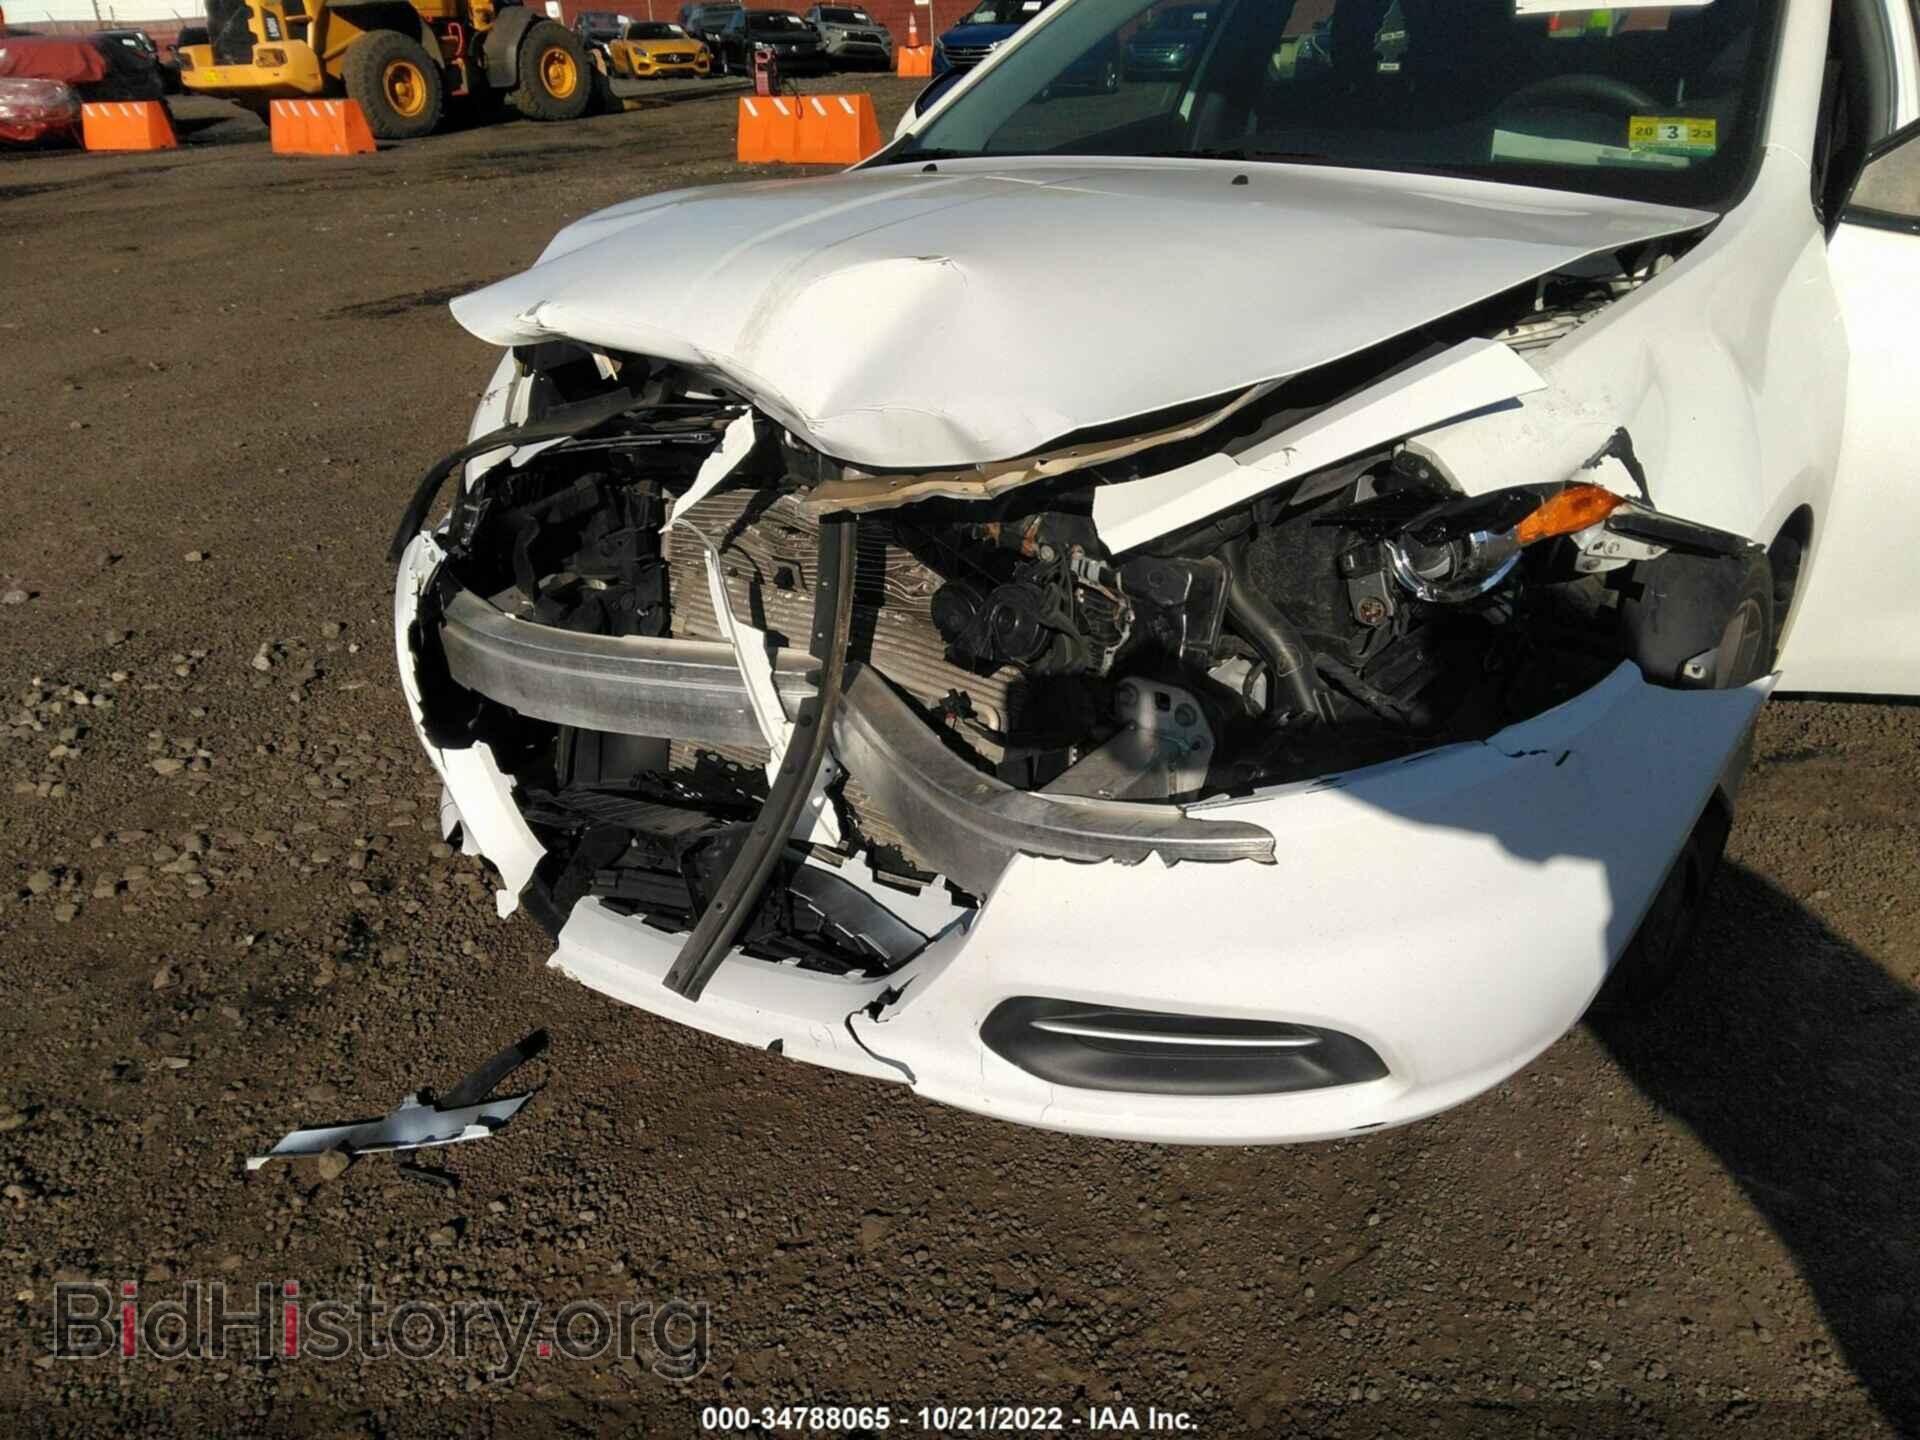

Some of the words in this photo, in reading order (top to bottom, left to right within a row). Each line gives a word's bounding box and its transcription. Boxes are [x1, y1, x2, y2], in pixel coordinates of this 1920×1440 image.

[1635, 127, 1653, 137] 20
[1667, 126, 1679, 140] 3
[1692, 129, 1712, 138] 23
